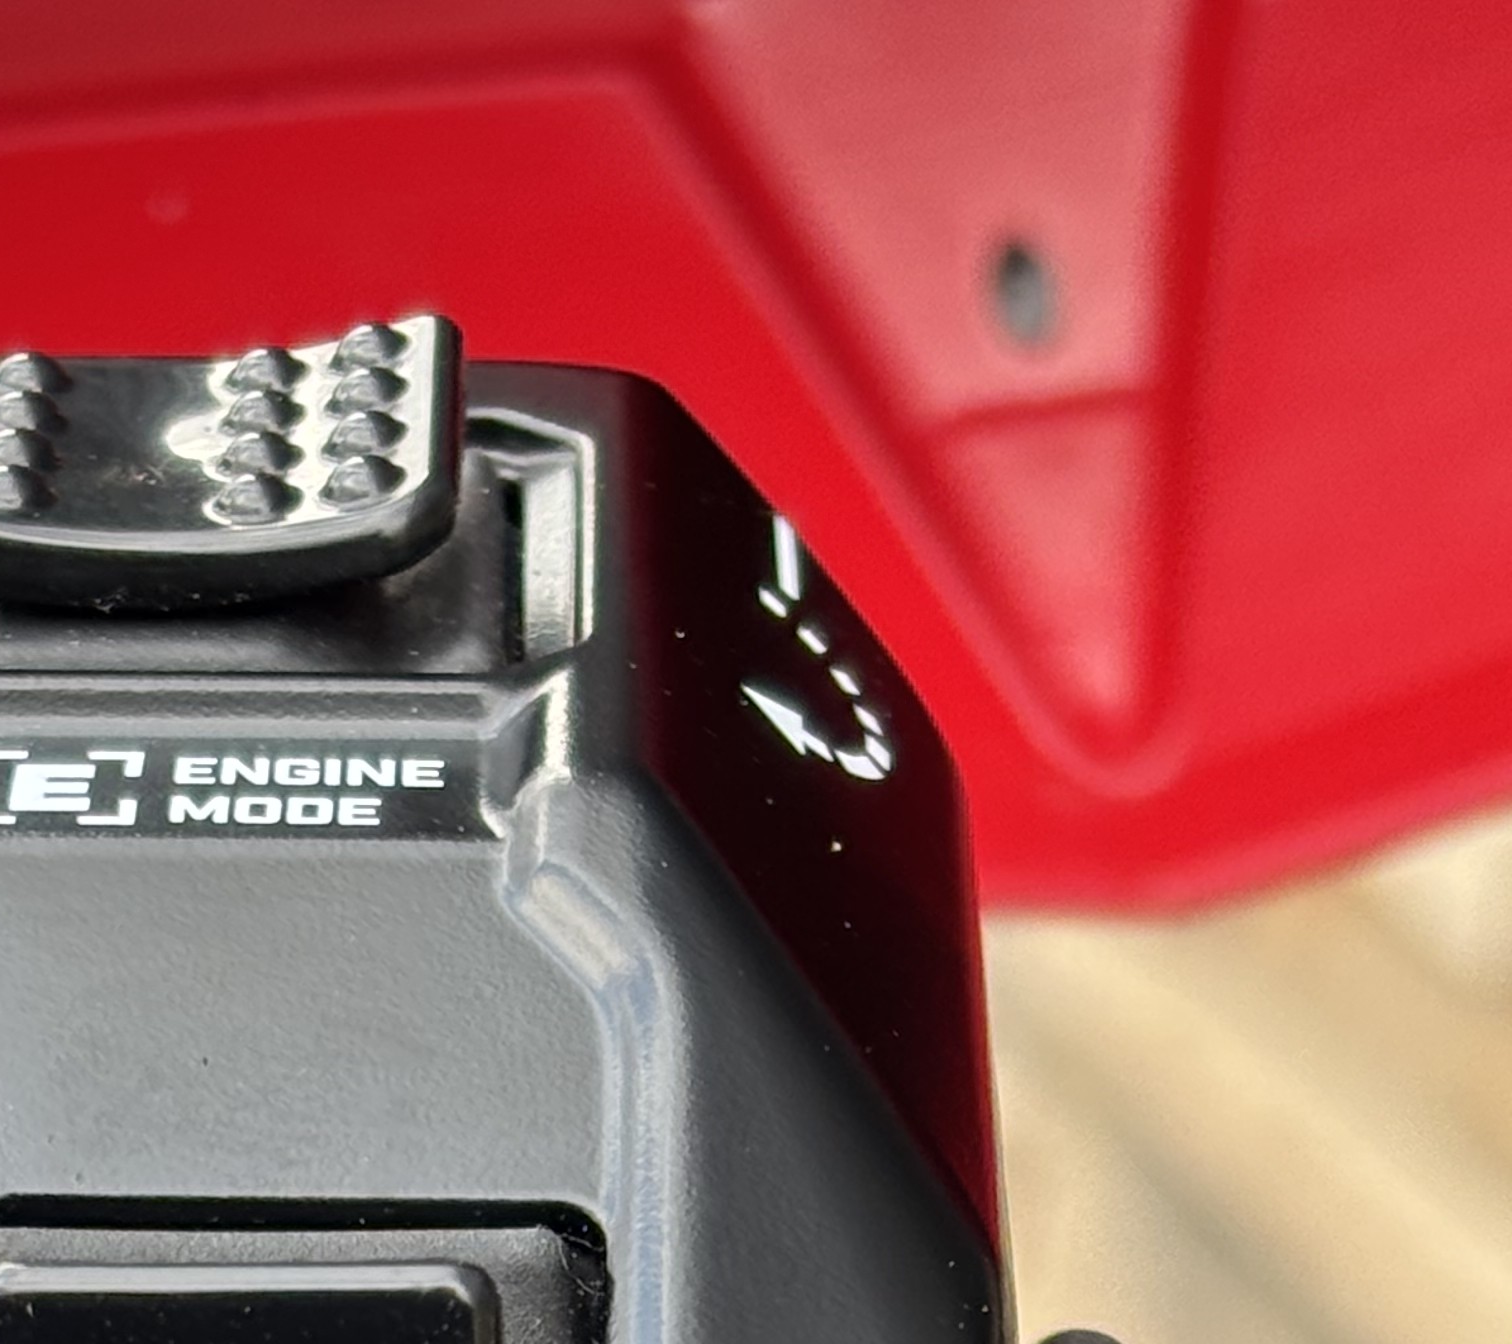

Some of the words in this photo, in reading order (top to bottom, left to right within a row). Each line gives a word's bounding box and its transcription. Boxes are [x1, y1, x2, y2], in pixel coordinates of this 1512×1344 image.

[8, 763, 96, 812] E
[173, 756, 446, 788] ENGINE
[168, 796, 383, 826] MODE
